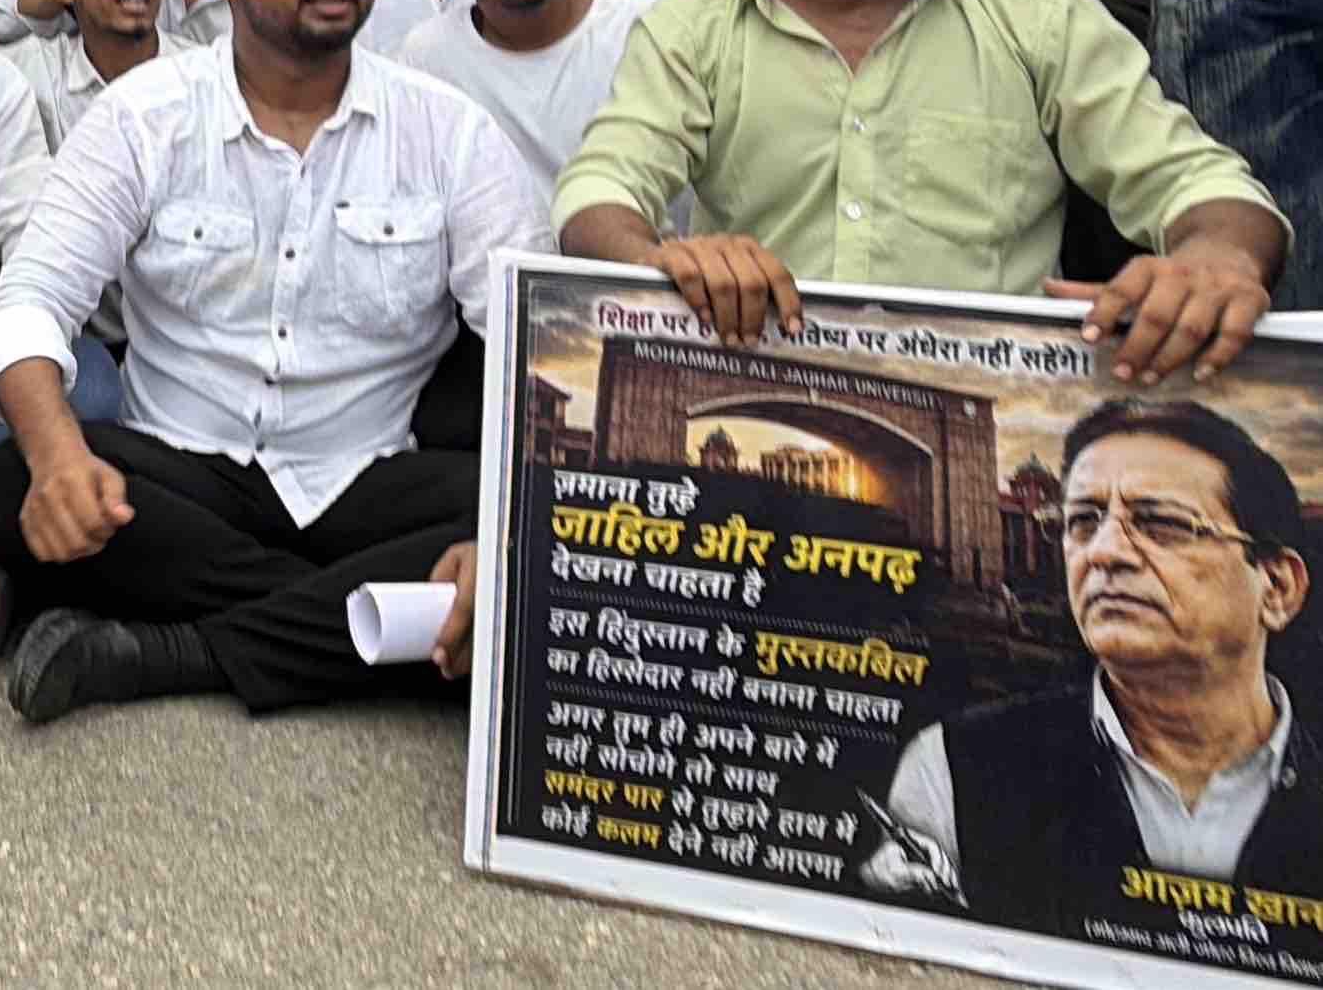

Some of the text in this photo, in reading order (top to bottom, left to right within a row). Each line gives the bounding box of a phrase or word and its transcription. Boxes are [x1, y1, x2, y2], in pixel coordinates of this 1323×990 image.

[598, 299, 654, 333] शिक्षा
[661, 313, 692, 334] पर
[857, 329, 887, 353] पर
[967, 338, 1016, 368] नहीं
[633, 341, 741, 375] MOHAMMAD
[747, 362, 777, 382] ALI
[782, 368, 850, 393] JAUHAR
[551, 541, 767, 609] देखना चाहता है
[552, 501, 922, 595] जाहिल और अनपढ़
[548, 606, 590, 638] इस
[716, 622, 746, 659] के
[755, 630, 930, 687] मुस्तकबिल
[547, 647, 580, 676] का
[691, 665, 738, 701] नहीं
[824, 687, 904, 726] चाहता
[547, 700, 607, 732] अगर
[694, 723, 756, 758] अपने
[764, 732, 808, 766] बारे
